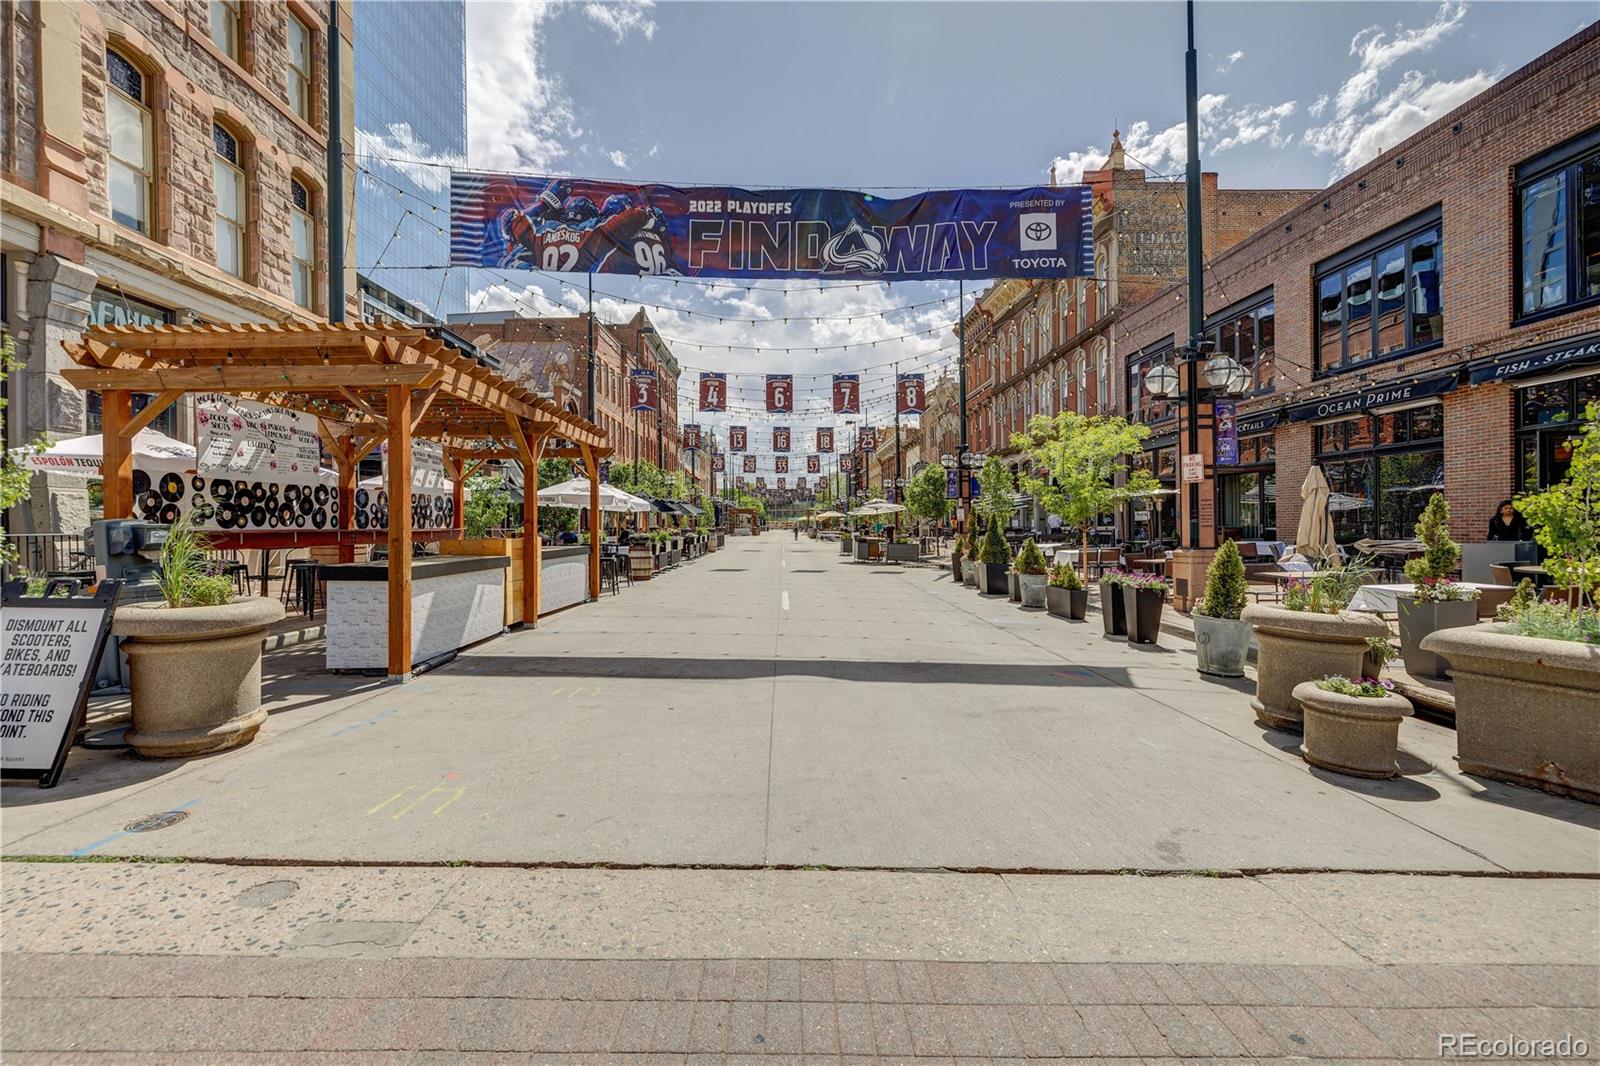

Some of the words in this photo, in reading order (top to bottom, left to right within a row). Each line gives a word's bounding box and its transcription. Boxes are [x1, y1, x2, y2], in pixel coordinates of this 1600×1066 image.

[688, 200, 722, 213] 2022
[727, 200, 793, 215] PLAYOFFS
[1010, 200, 1054, 208] PRESENTED
[1055, 199, 1066, 207] BY
[688, 218, 831, 273] FIND
[872, 220, 998, 274] WAY
[634, 241, 667, 276] 96
[1012, 257, 1068, 270] TOYOTA
[1495, 360, 1531, 377] FISH
[1542, 343, 1600, 365] STEAK
[638, 383, 649, 404] 3
[707, 385, 719, 406] 4
[774, 386, 786, 408] 6
[841, 387, 852, 408] 7
[906, 386, 918, 407] 8
[1317, 399, 1362, 418] OCEAN
[1366, 387, 1412, 411] PRIME
[733, 434, 744, 447] 13
[777, 434, 788, 448] 16
[820, 434, 831, 448] 18
[861, 434, 875, 448] 25
[75, 458, 104, 468] TEQUI
[712, 459, 723, 469] 28
[745, 460, 756, 471] 29
[776, 461, 788, 471] 35
[808, 460, 819, 471] 37
[841, 459, 852, 470] 39
[5, 618, 64, 633] DISMOUNT
[65, 619, 88, 633] ALL
[11, 634, 72, 648] SCOOTERS,
[4, 648, 41, 662] BIKES,
[44, 649, 71, 662] AND
[0, 693, 9, 706] O
[10, 693, 51, 707] RIDING
[0, 709, 25, 723] OND
[28, 709, 55, 723] THIS
[0, 724, 27, 738] OINT.
